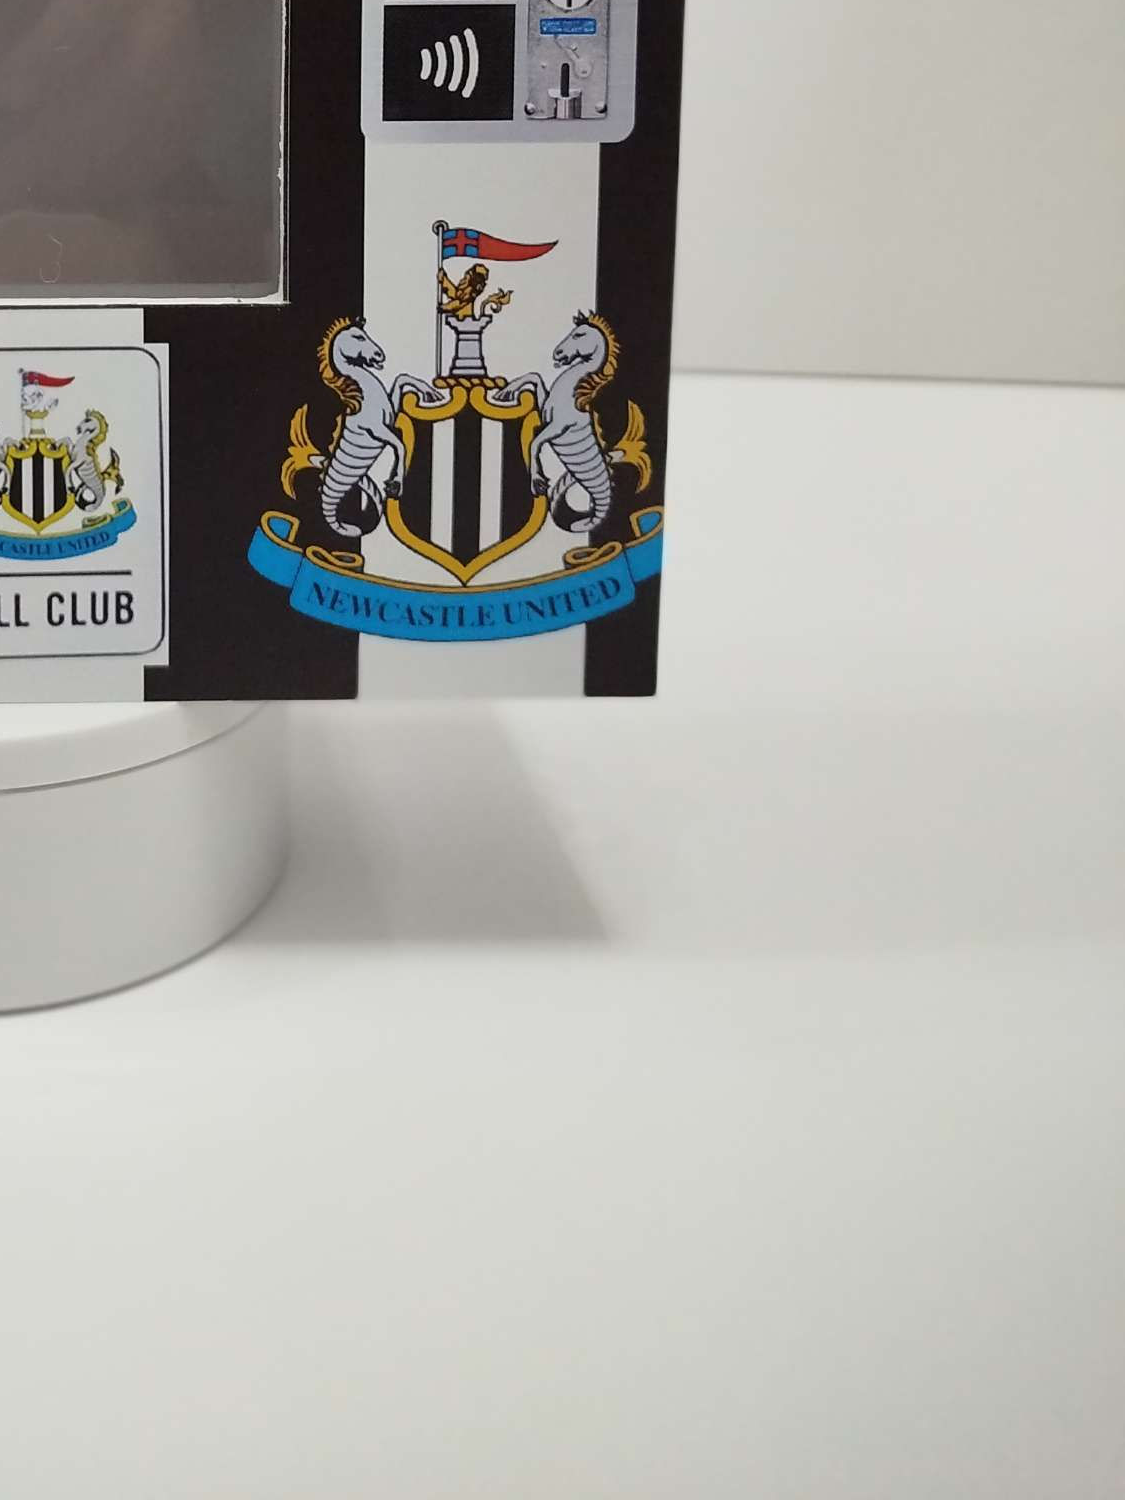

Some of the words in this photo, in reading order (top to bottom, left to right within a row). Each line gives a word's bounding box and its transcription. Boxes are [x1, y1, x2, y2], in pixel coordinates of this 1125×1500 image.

[46, 590, 137, 628] CLUB
[306, 581, 496, 628] NEWCASTLE
[502, 577, 622, 623] UNITED
